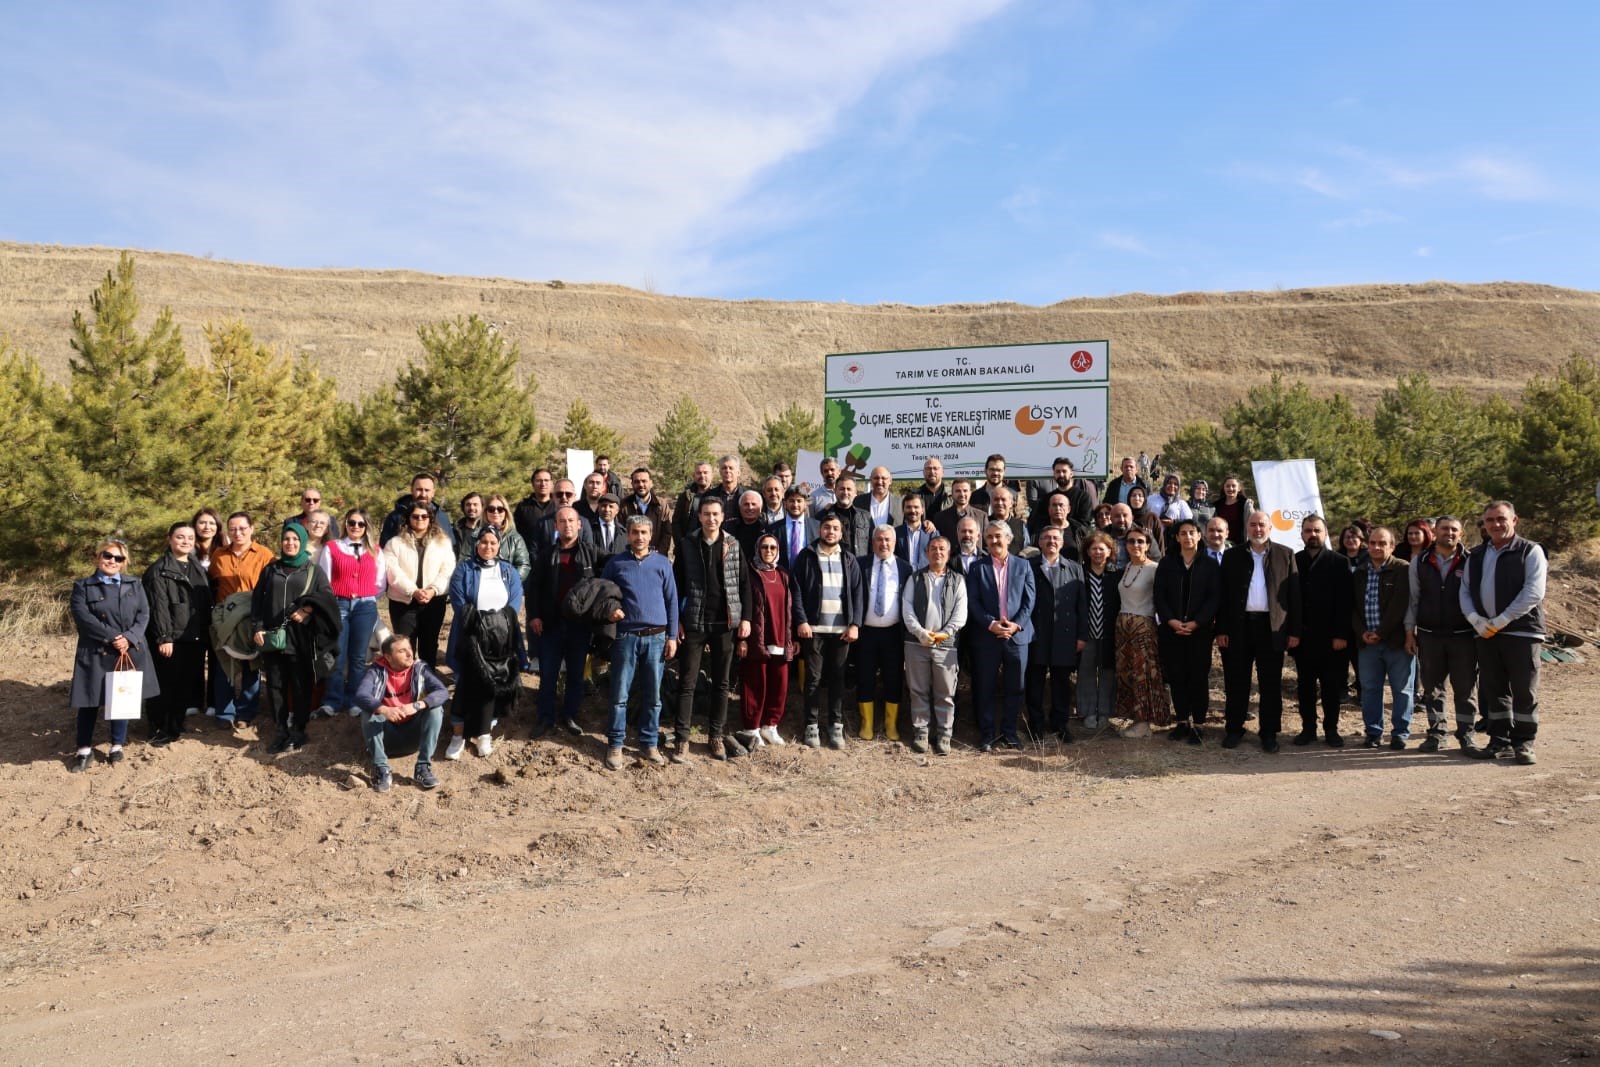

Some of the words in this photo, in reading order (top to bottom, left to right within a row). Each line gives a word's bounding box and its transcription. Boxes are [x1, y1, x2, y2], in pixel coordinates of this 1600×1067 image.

[896, 370, 924, 380] TARIM
[927, 369, 939, 378] VE
[941, 368, 977, 377] ORMAN
[979, 364, 1034, 376] BAKANLIĞI
[925, 397, 942, 409] T.C.
[860, 413, 893, 426] ÖLÇME,
[896, 412, 928, 426] SEÇME
[930, 411, 942, 422] VE
[945, 408, 1011, 425] YERLEŞTİRME
[1031, 404, 1077, 419] ÖSYM
[884, 426, 924, 438] MERKEZİ
[927, 424, 984, 439] BAŞKANLIĞI
